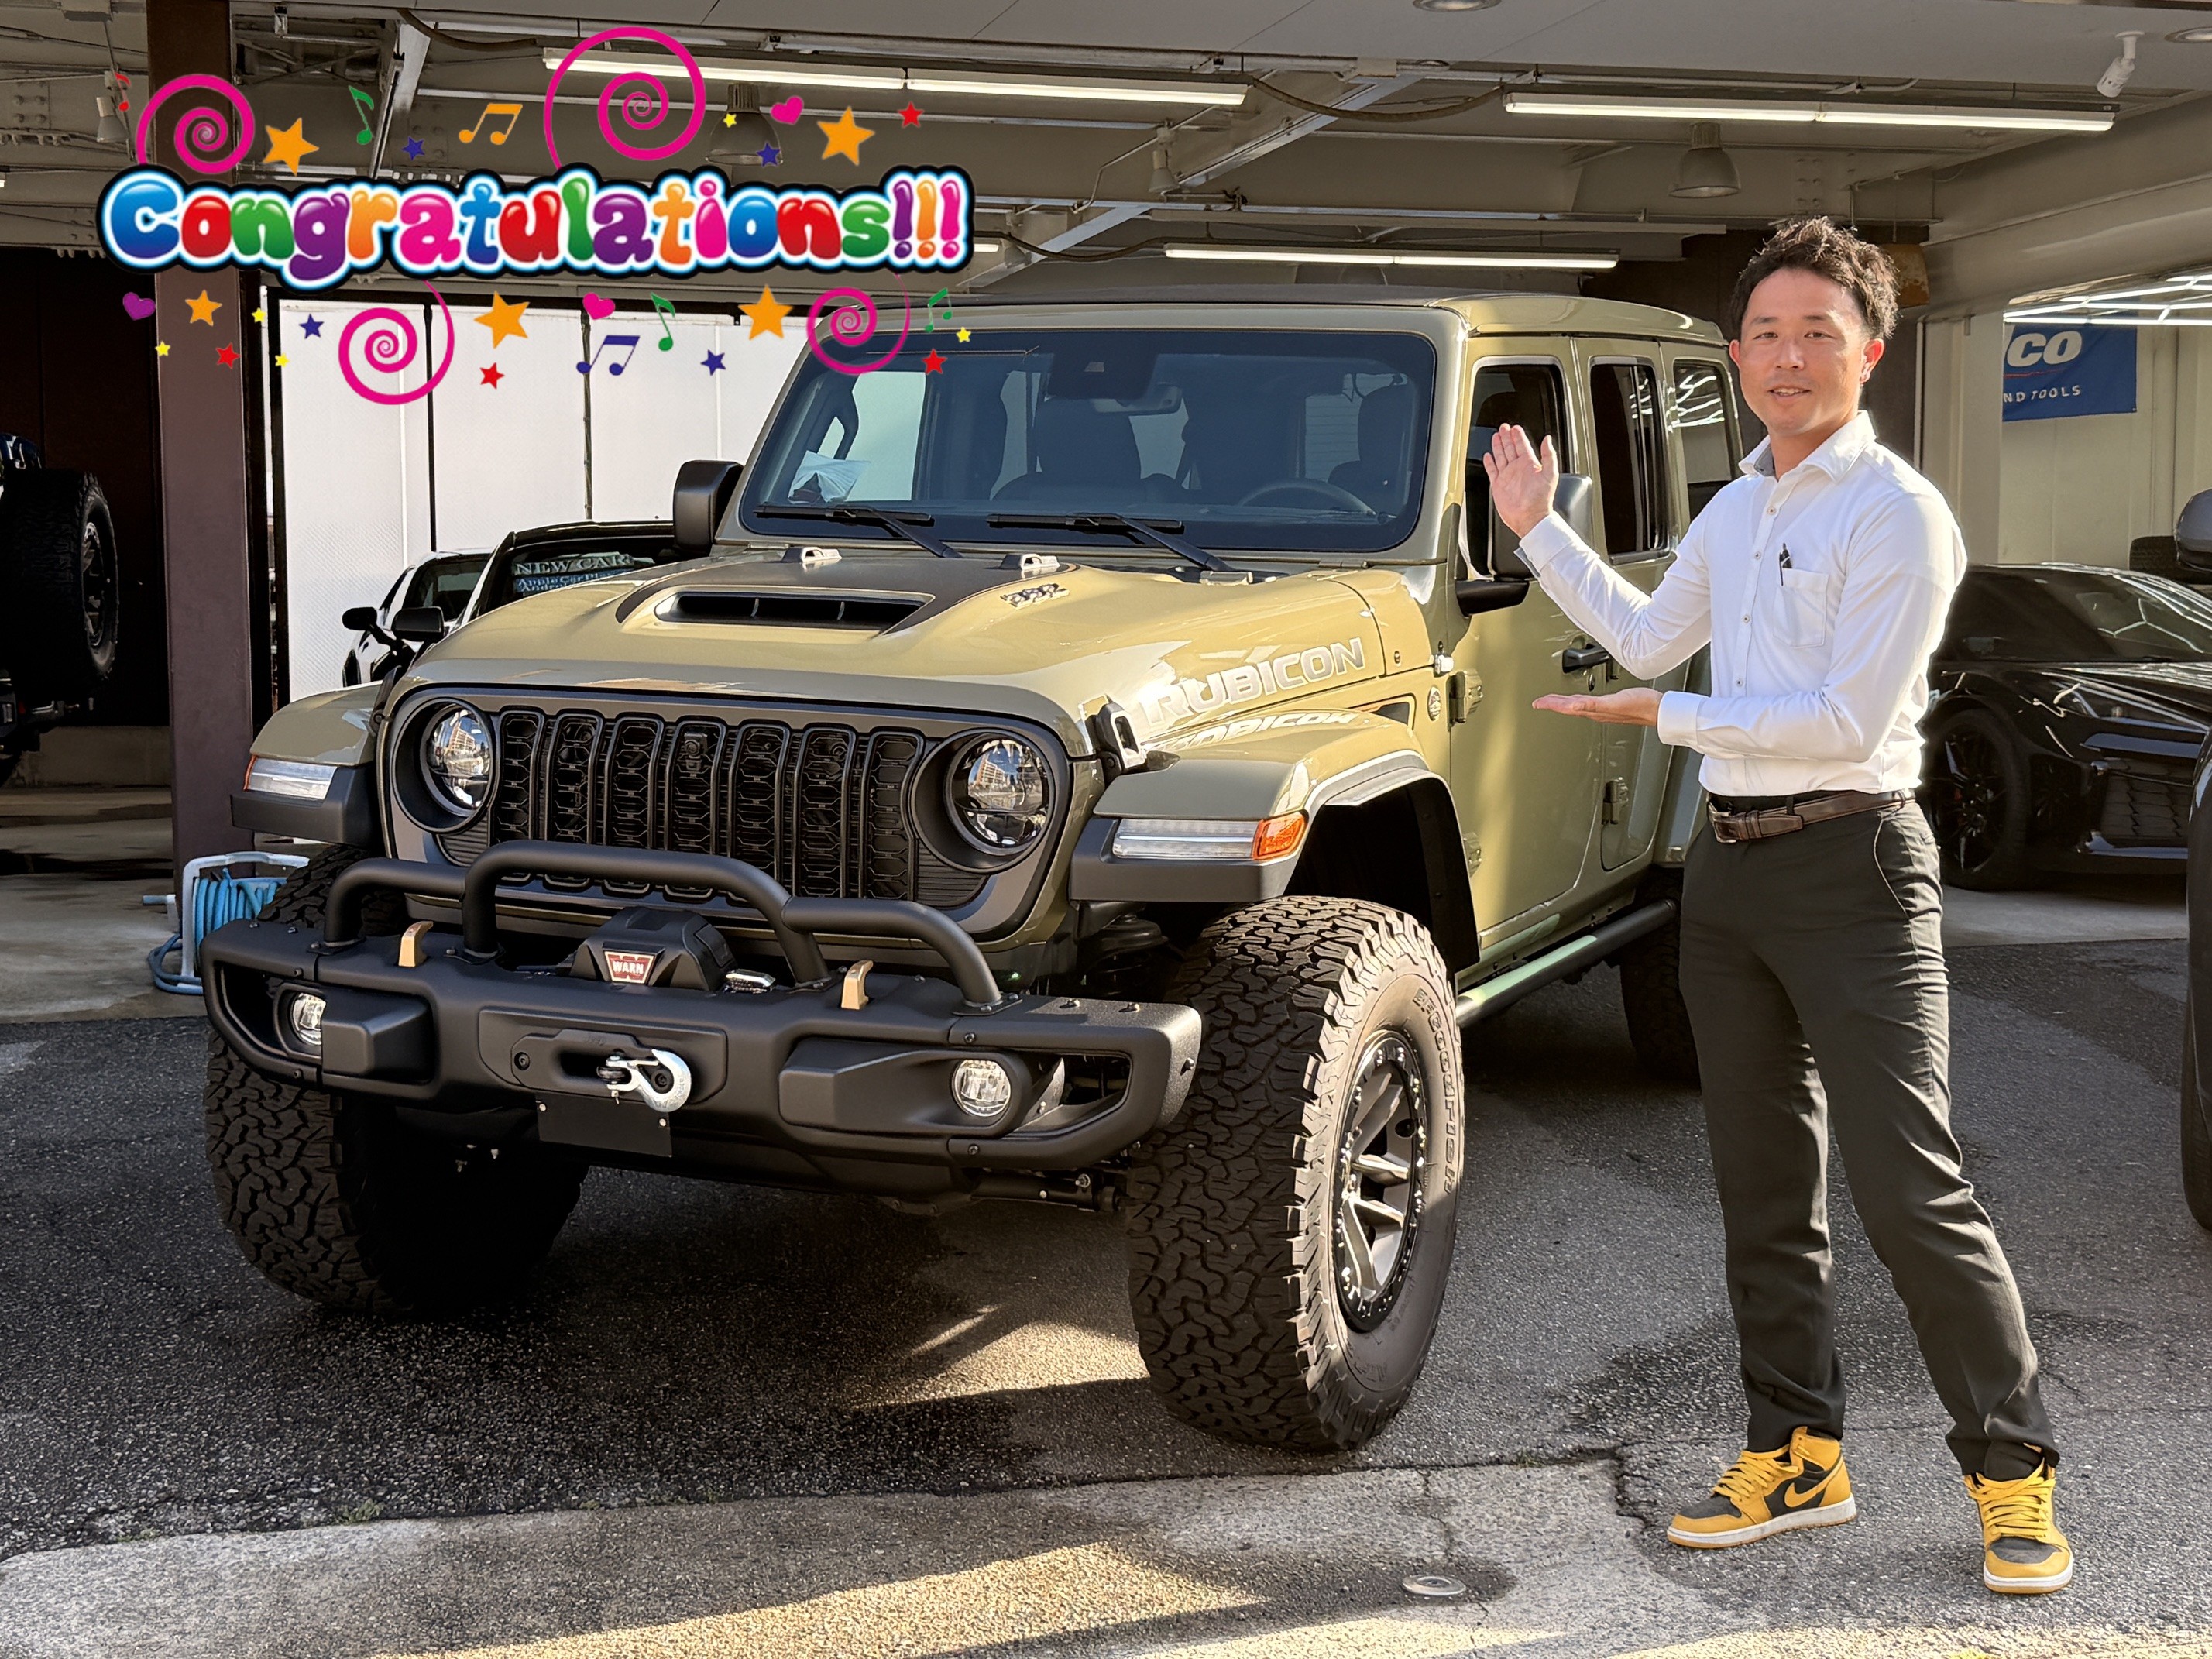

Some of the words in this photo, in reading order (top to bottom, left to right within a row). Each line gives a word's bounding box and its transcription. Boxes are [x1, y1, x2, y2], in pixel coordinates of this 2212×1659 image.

[2004, 326, 2083, 367] CO
[2004, 391, 2026, 403] ND
[2031, 384, 2081, 401] TOOLS
[515, 561, 572, 575] NEW
[576, 554, 629, 570] CAR
[1138, 637, 1366, 726] RUBICON
[612, 960, 644, 975] WARN
